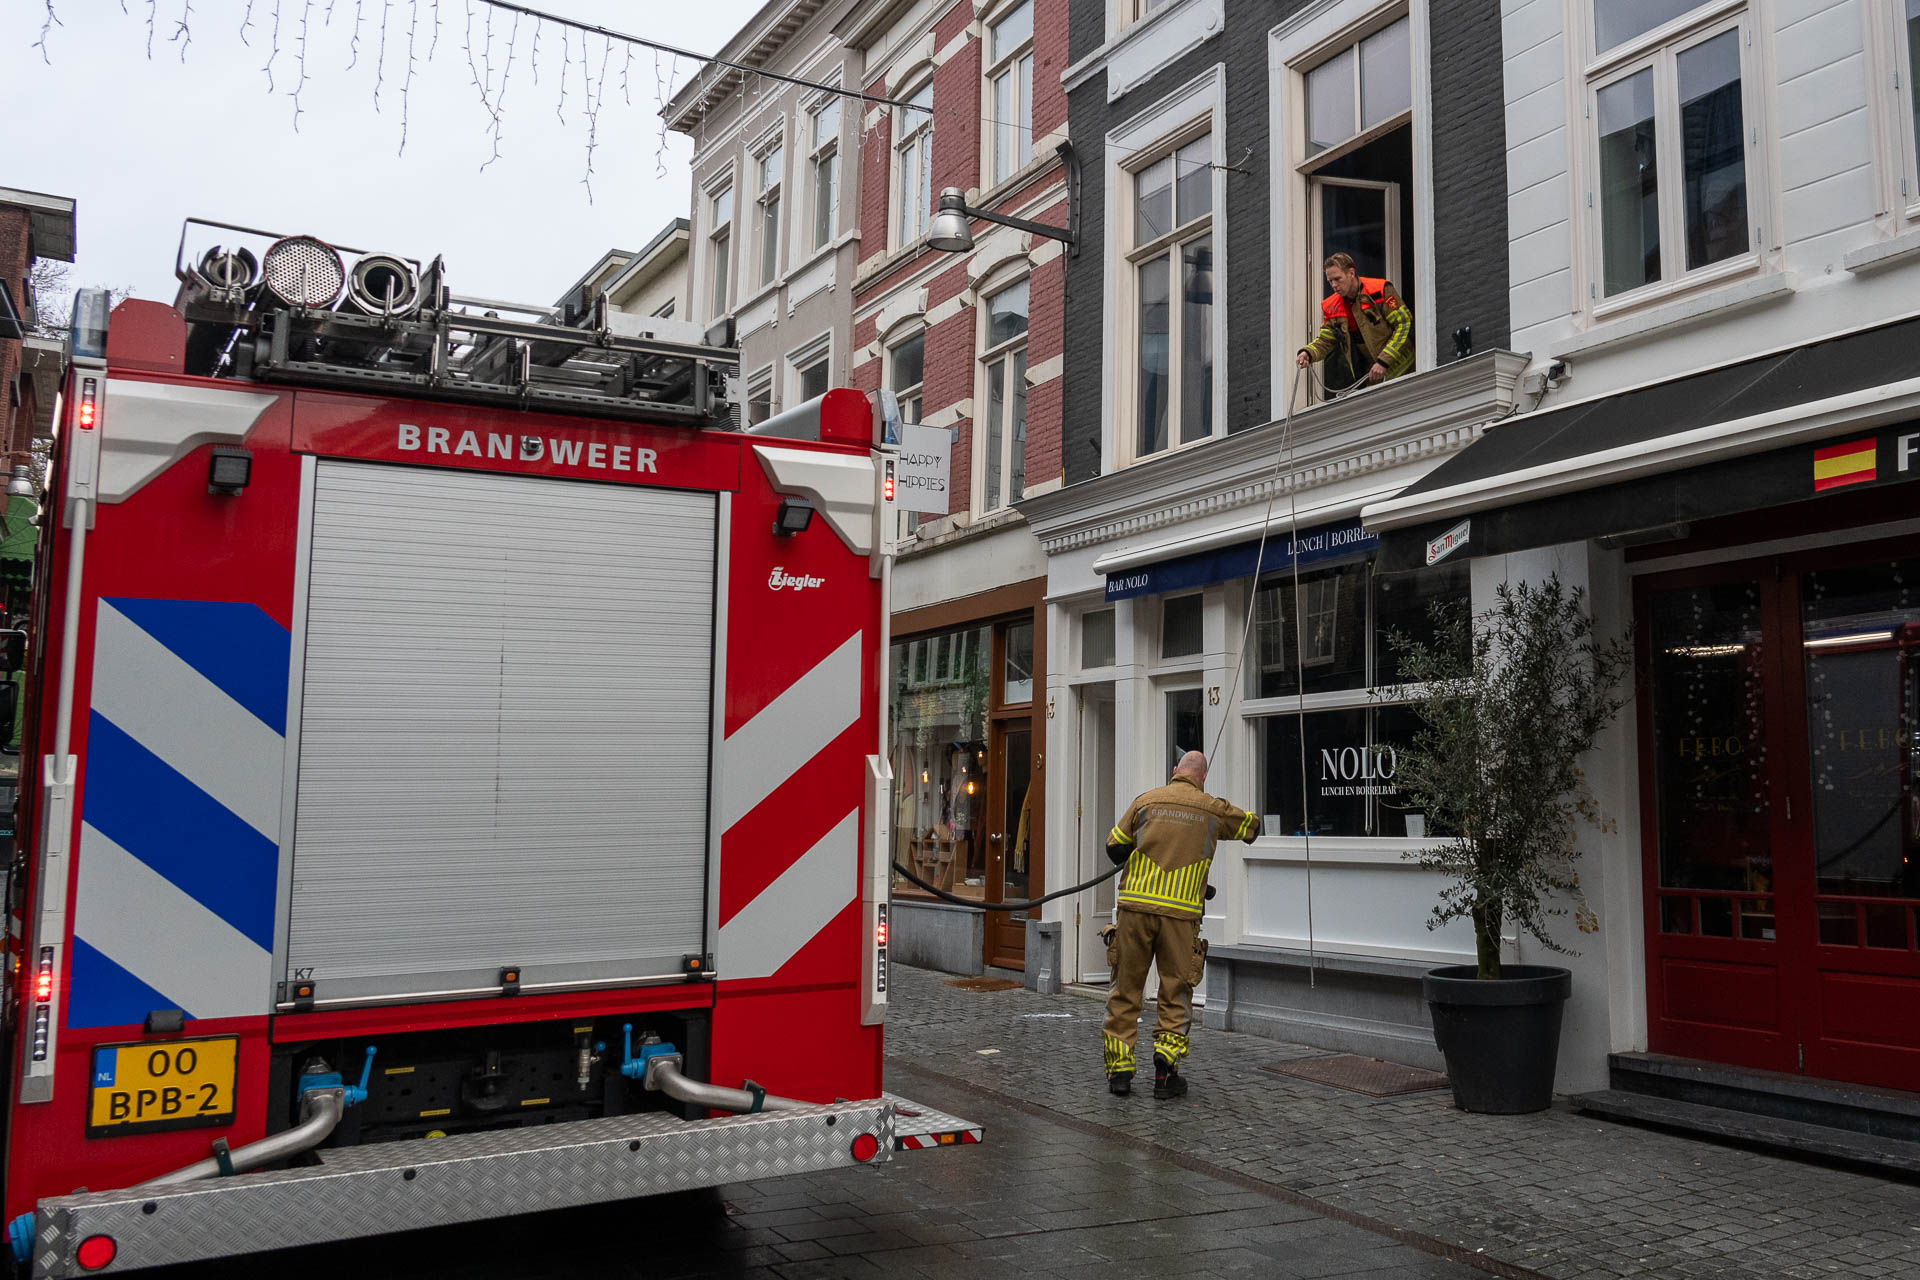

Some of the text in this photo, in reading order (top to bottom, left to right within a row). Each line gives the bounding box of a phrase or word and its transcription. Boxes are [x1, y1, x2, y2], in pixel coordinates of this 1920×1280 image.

[397, 423, 658, 474] BRANDWEER
[899, 451, 942, 469] HAPPY
[898, 474, 945, 492] HIPPIES
[1287, 535, 1323, 556] LUNCH
[768, 566, 825, 591] Ziegler
[1108, 573, 1149, 593] BAR NOLO
[1207, 686, 1220, 706] 13
[1320, 745, 1397, 781] NOLO
[1321, 785, 1397, 796] LUNCH EN BORRELBAR
[1151, 808, 1205, 824] BRANDWEER
[295, 967, 314, 980] K7
[98, 1072, 112, 1081] NL
[110, 1083, 218, 1120] BPB-2
